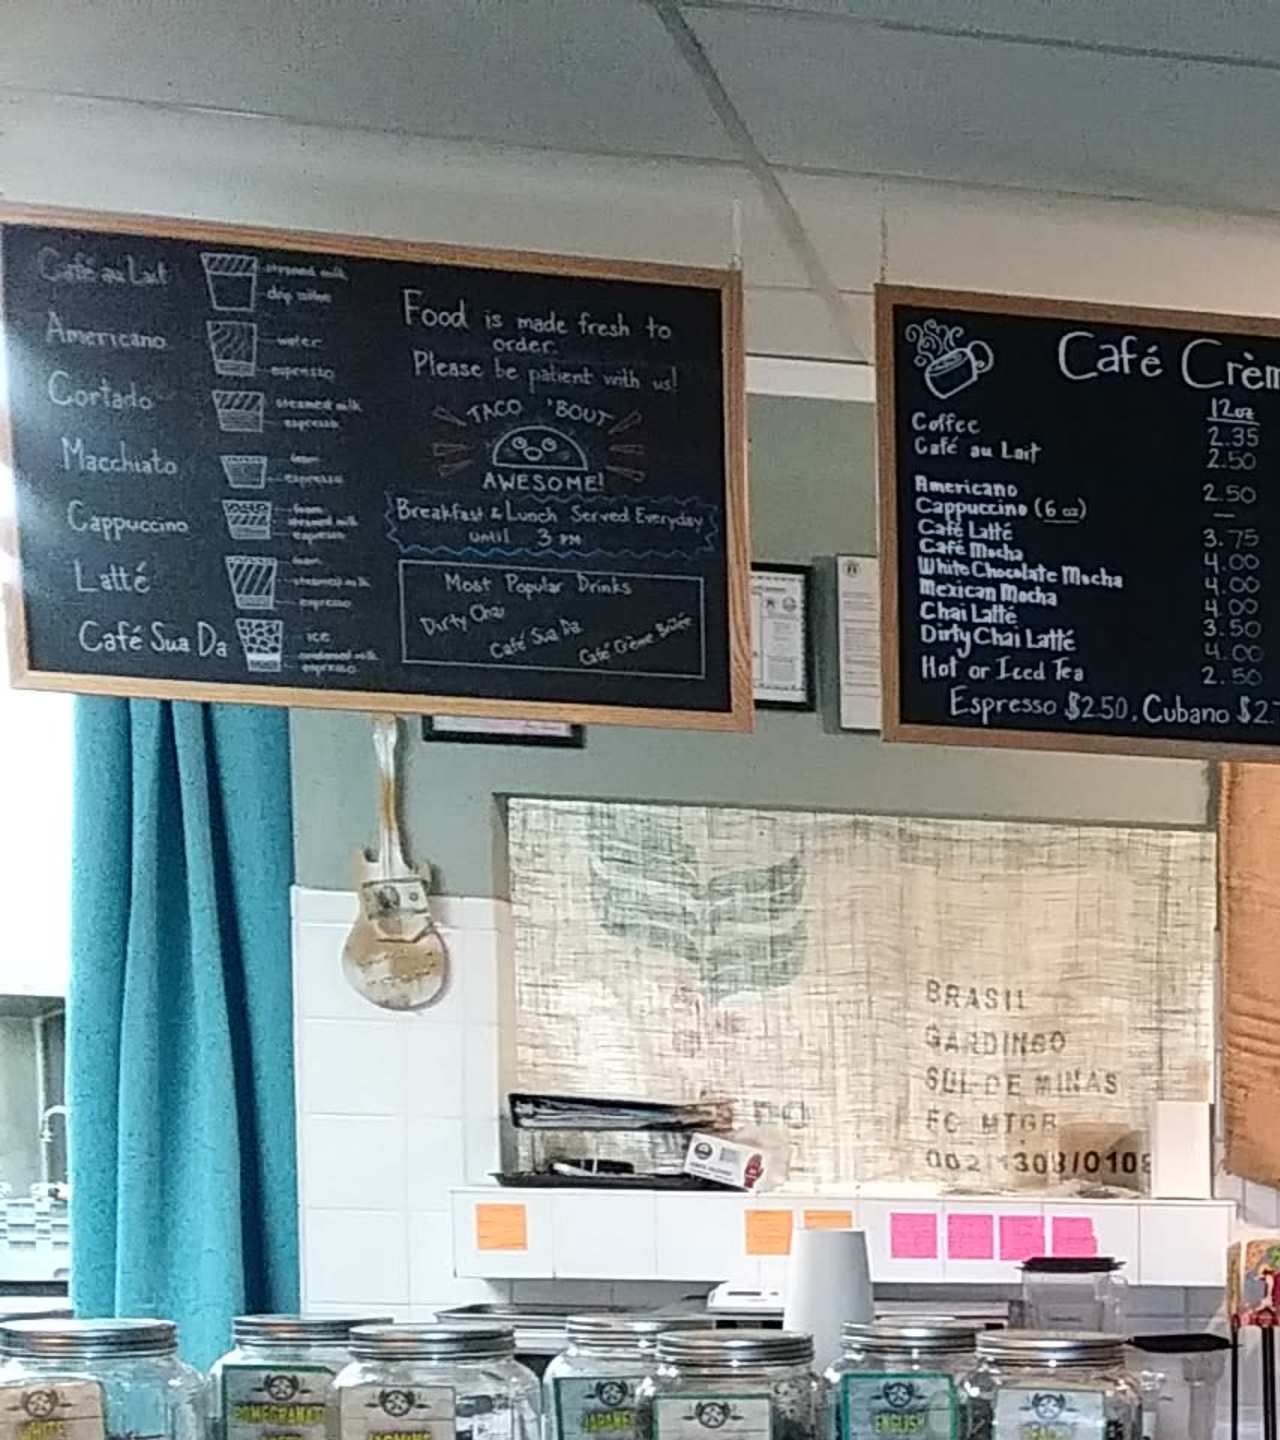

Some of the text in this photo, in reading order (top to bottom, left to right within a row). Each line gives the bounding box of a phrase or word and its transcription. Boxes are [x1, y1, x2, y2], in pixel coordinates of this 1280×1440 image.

[403, 289, 671, 339] Food is made fresh to
[46, 311, 166, 350] Americano
[414, 351, 678, 393] Please be patient with us!
[1058, 331, 1164, 381] Café
[48, 370, 153, 409] Cortado
[466, 398, 615, 426] TACO 'BOUT
[911, 411, 982, 434] Coffee
[61, 436, 178, 475] Macchiato
[914, 437, 958, 456] Café
[970, 445, 992, 459] au
[1001, 441, 1042, 463] Lait
[482, 472, 604, 493] AWESOME!
[914, 474, 1018, 498] Americano
[67, 499, 189, 541] Cappuccino
[397, 498, 704, 530] Breakfast Lunch Served Everyday
[915, 498, 1028, 522] Cappuccino
[469, 528, 581, 547] until 3 PM
[918, 519, 963, 537] Café
[969, 520, 1013, 541] Latté
[919, 539, 1023, 562] Café Mocha
[73, 560, 150, 594] Latté
[445, 573, 632, 600] Most Popular Drinks
[918, 557, 1123, 588] White Chocolate Mocha
[919, 579, 1058, 606] Mexican Mocha
[420, 604, 505, 636] Dirty Chai
[919, 602, 967, 622] Chai
[971, 603, 1018, 625] Latté
[79, 621, 228, 658] Café Sua Da
[490, 632, 526, 659] Café
[531, 625, 559, 645] Sua
[921, 624, 1076, 658] Dirty Chai Latté
[921, 655, 1084, 681] Hot or Iced Tea
[949, 685, 1057, 724] Espresso
[1143, 694, 1230, 724] Cubano
[926, 979, 1027, 1011] BRASIL
